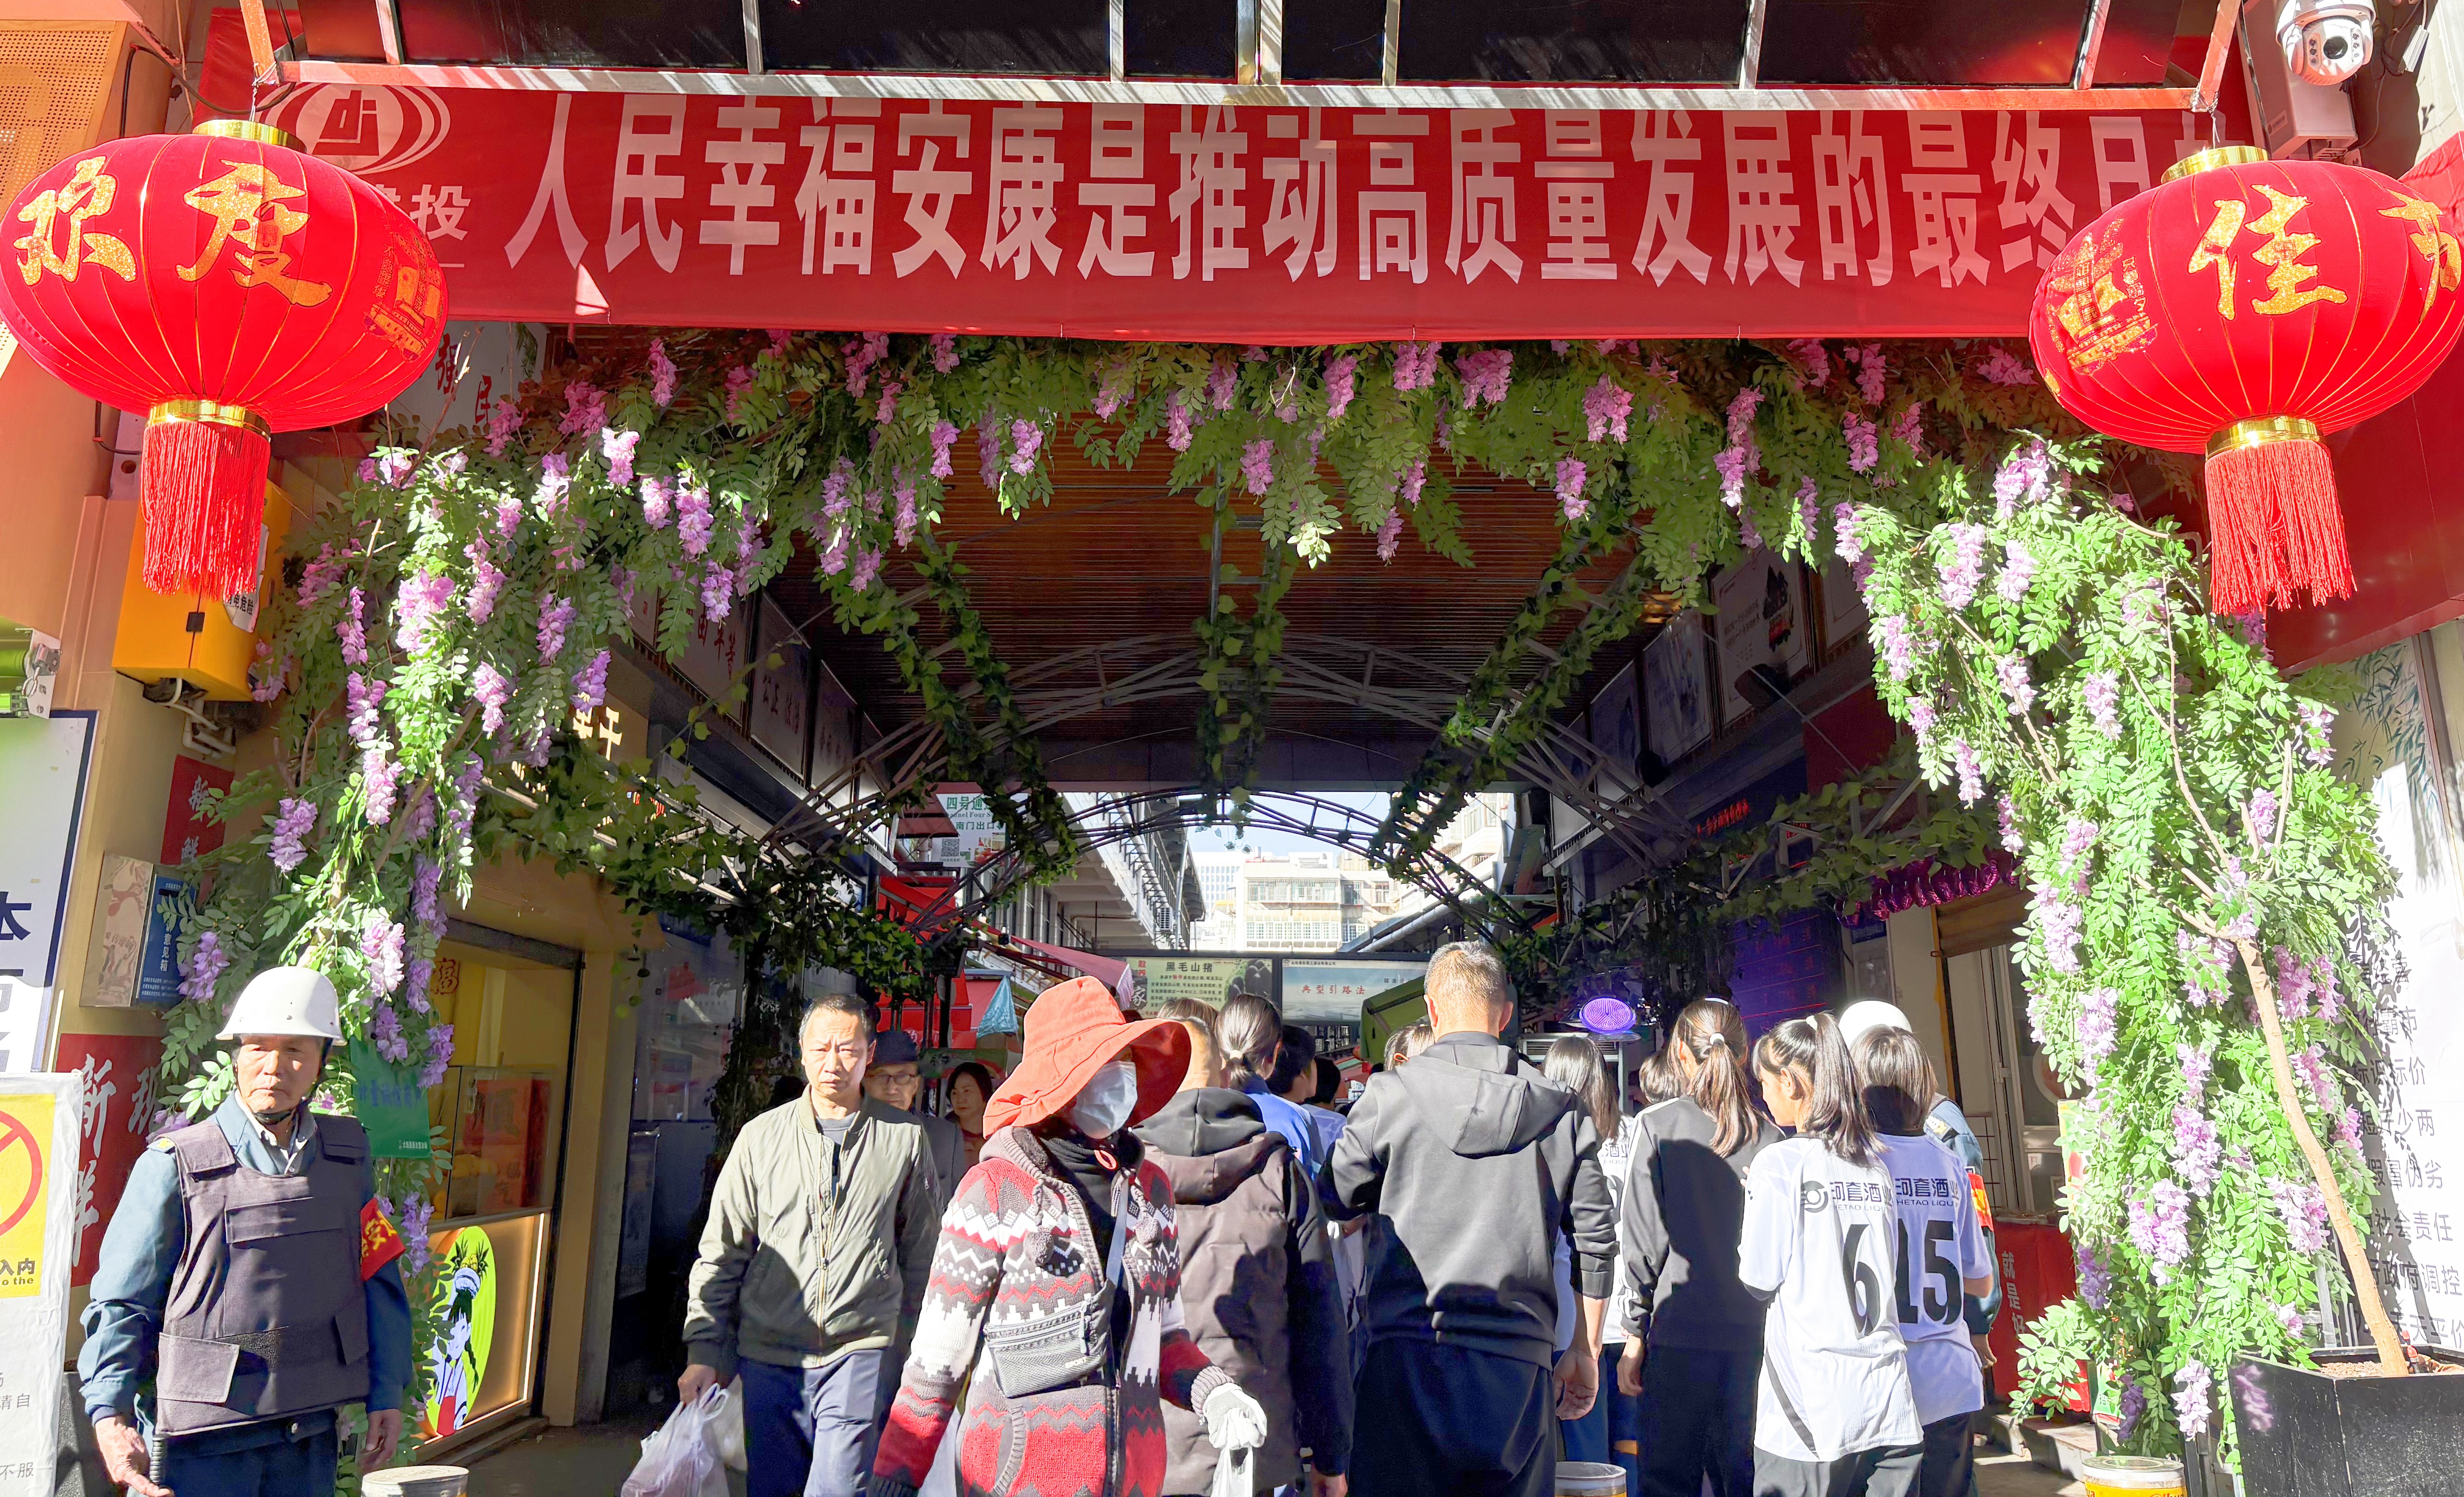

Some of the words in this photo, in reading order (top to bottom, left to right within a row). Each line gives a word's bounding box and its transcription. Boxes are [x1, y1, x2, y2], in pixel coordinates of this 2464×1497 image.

[505, 94, 2245, 288] 人民幸福安康是推动高质量发展的最终目
[378, 184, 471, 240] 投
[956, 821, 994, 830] 南门出口
[1166, 962, 1213, 973] 黑毛山猪
[1302, 984, 1365, 995] 典型引路法
[13, 1277, 34, 1286] the
[1842, 1223, 1881, 1340] 6
